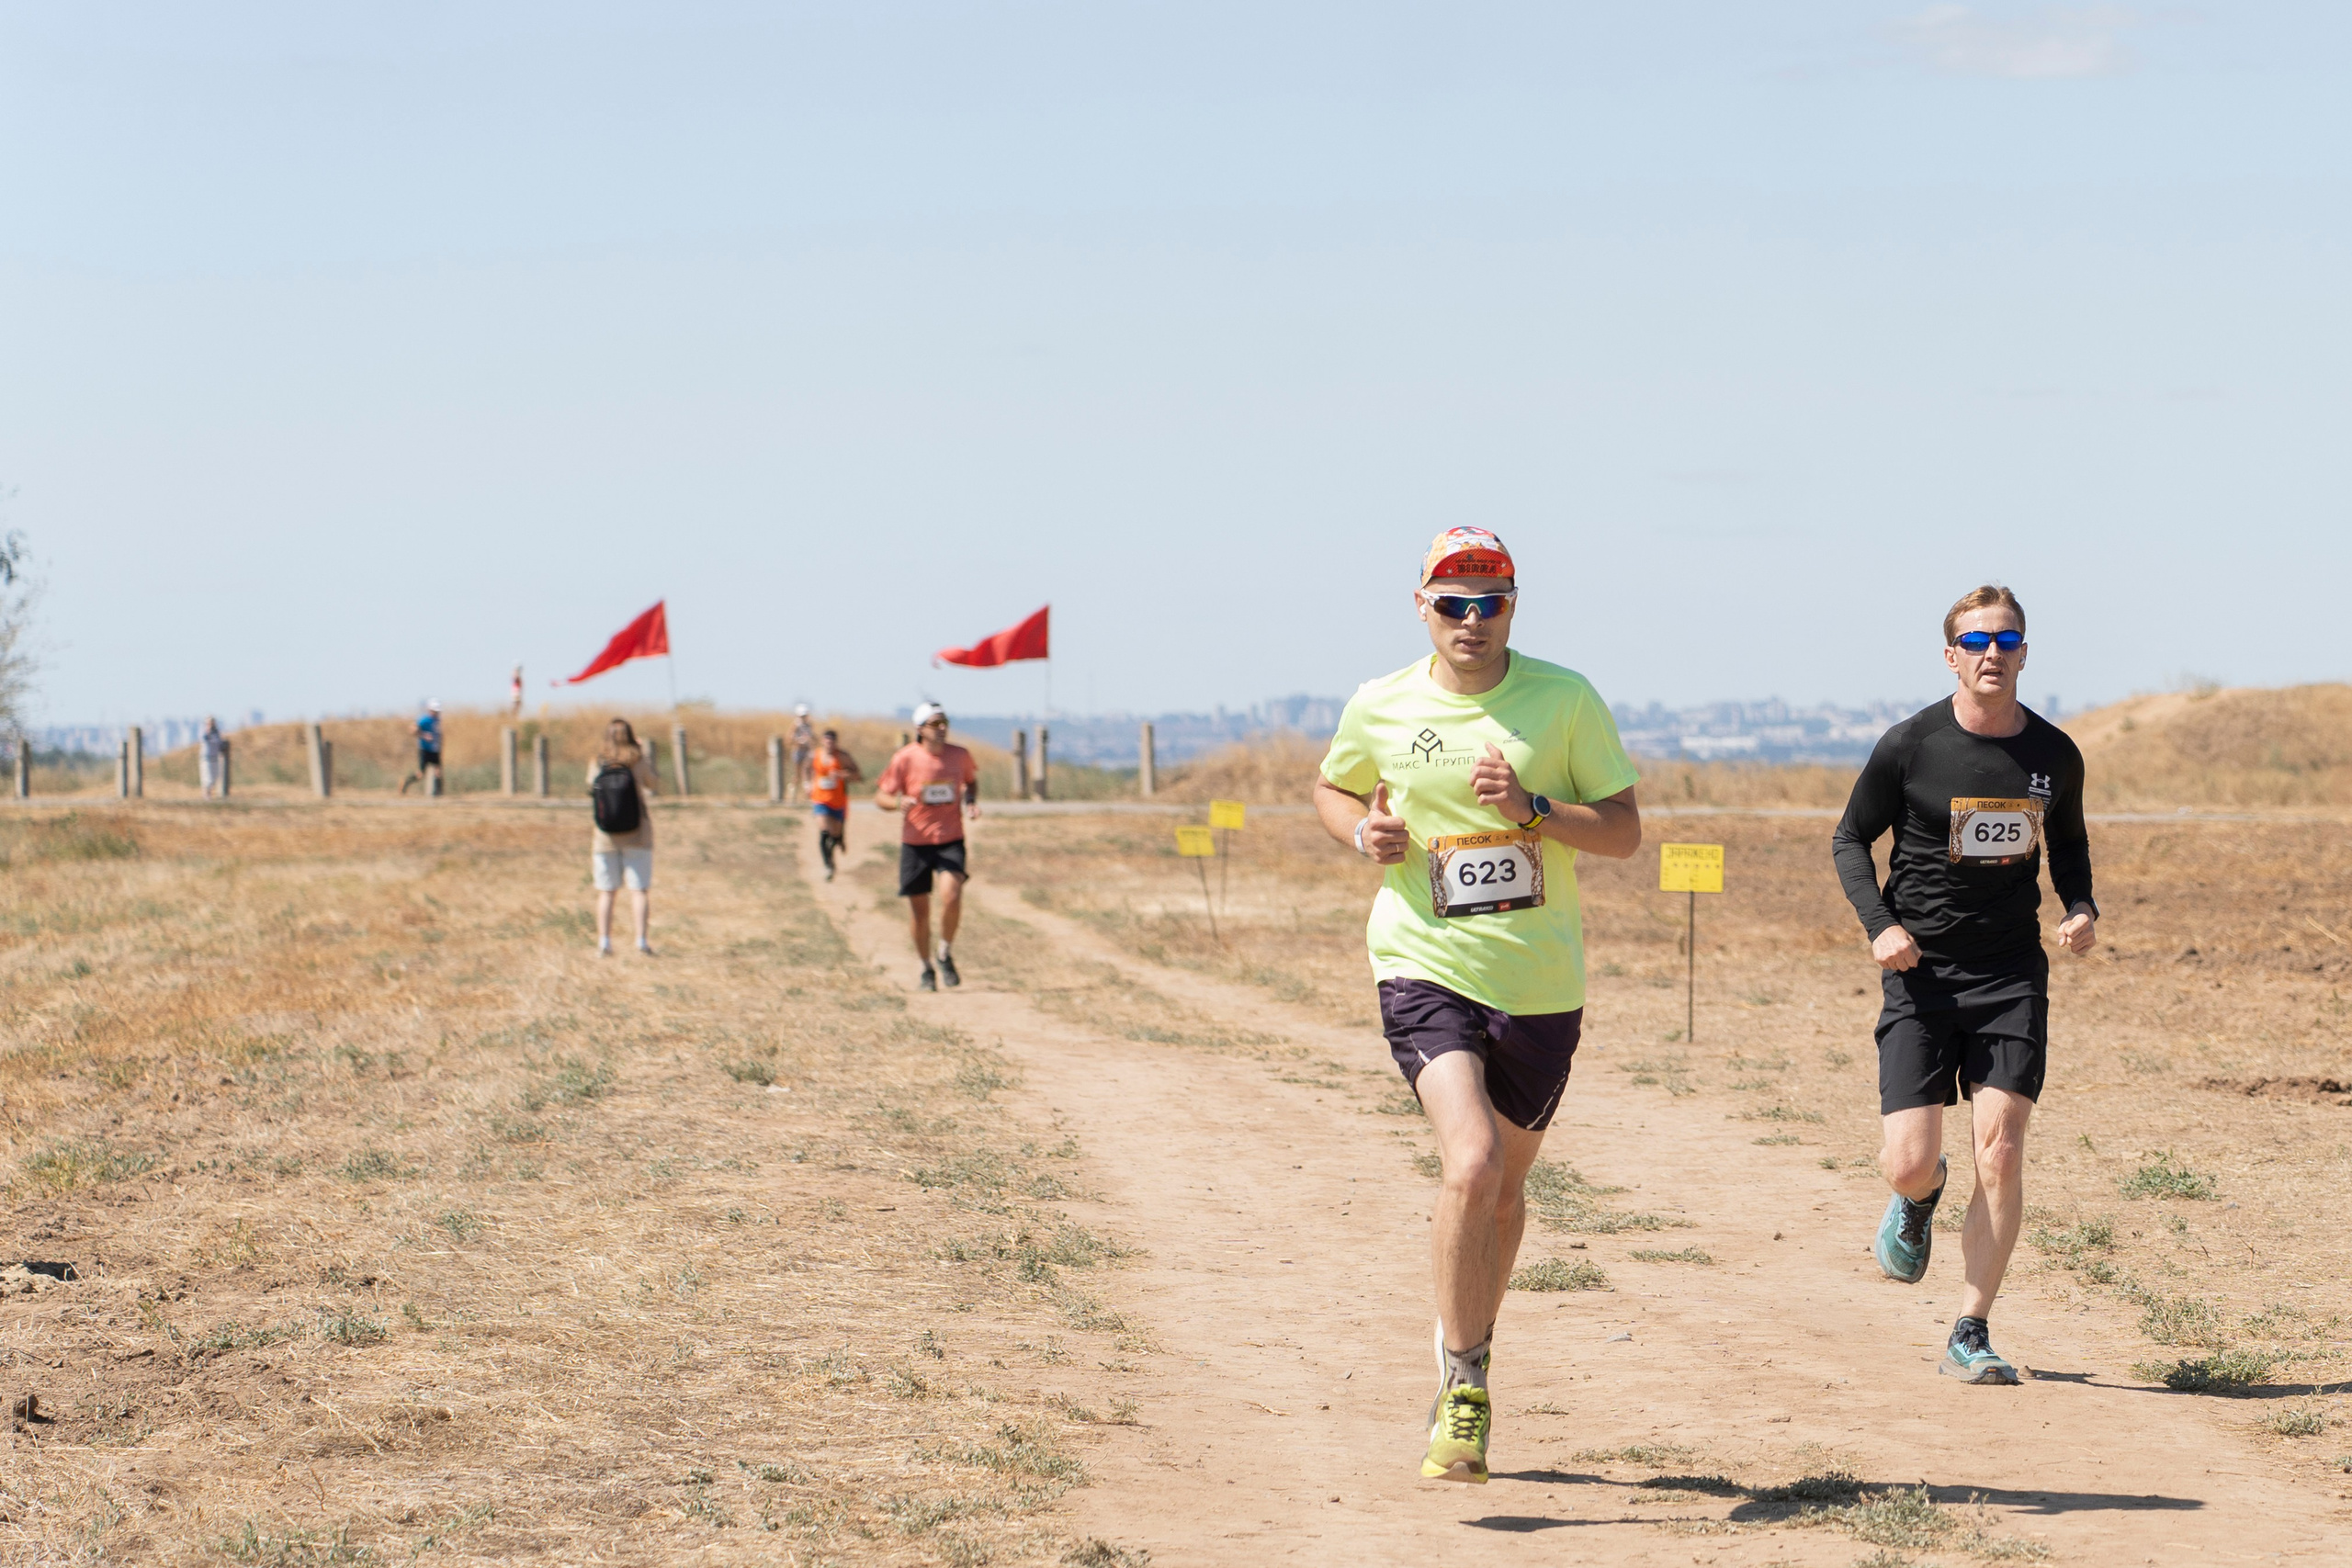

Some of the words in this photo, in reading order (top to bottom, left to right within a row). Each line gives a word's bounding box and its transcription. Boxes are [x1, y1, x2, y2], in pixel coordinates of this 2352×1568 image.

[1392, 760, 1420, 771] МАКС
[1435, 755, 1476, 768] ГРУПП
[1977, 800, 2006, 809] ПЕСОК
[1974, 822, 2021, 842] 625
[1457, 835, 1492, 846] ПЕСОК
[1459, 858, 1517, 886] 623
